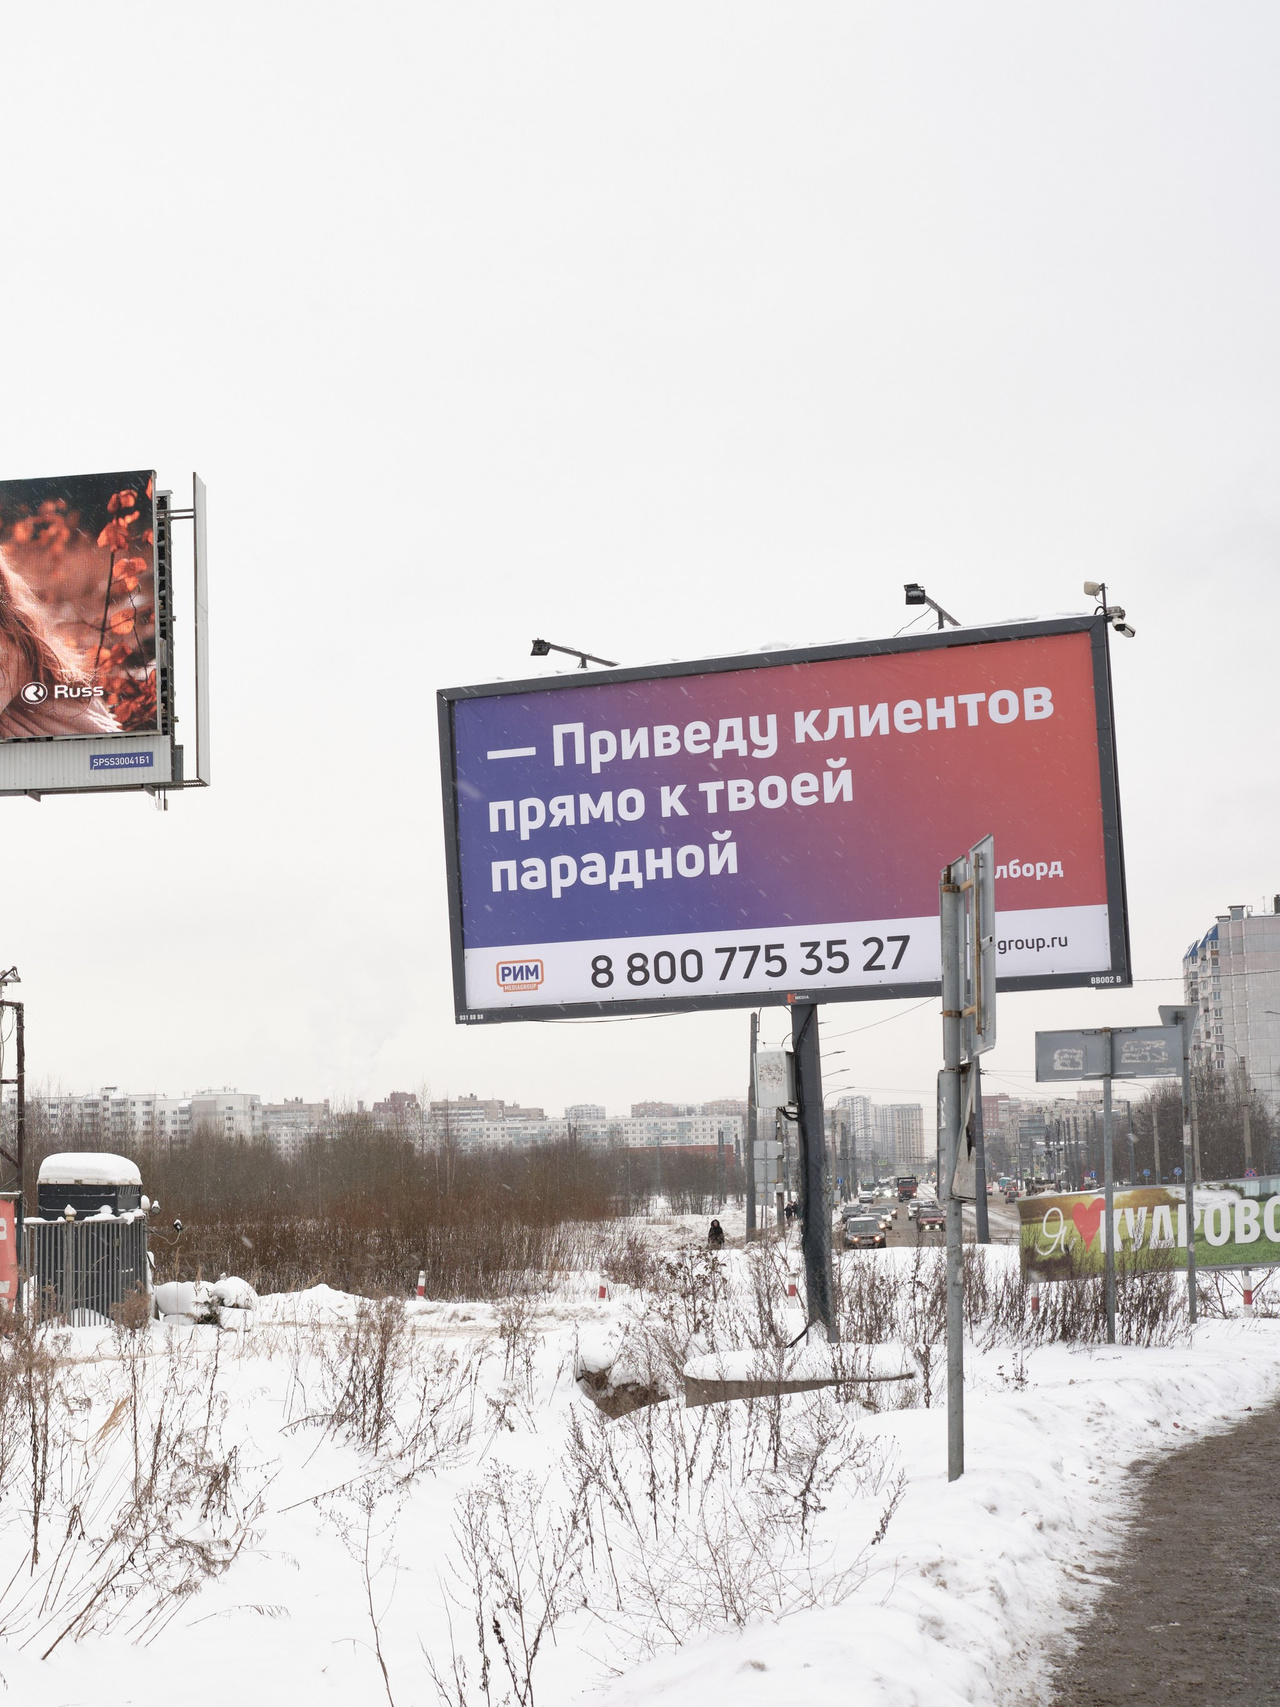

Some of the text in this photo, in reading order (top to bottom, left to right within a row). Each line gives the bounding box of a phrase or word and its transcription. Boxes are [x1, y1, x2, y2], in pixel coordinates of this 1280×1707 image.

[53, 682, 104, 700] Russ
[553, 714, 777, 773] Приведу
[794, 686, 1054, 743] клиентов
[489, 757, 853, 840] прямо к твоей
[491, 830, 738, 898] парадной
[501, 964, 539, 982] РИМ
[591, 935, 910, 988] 8 800 775 35 27
